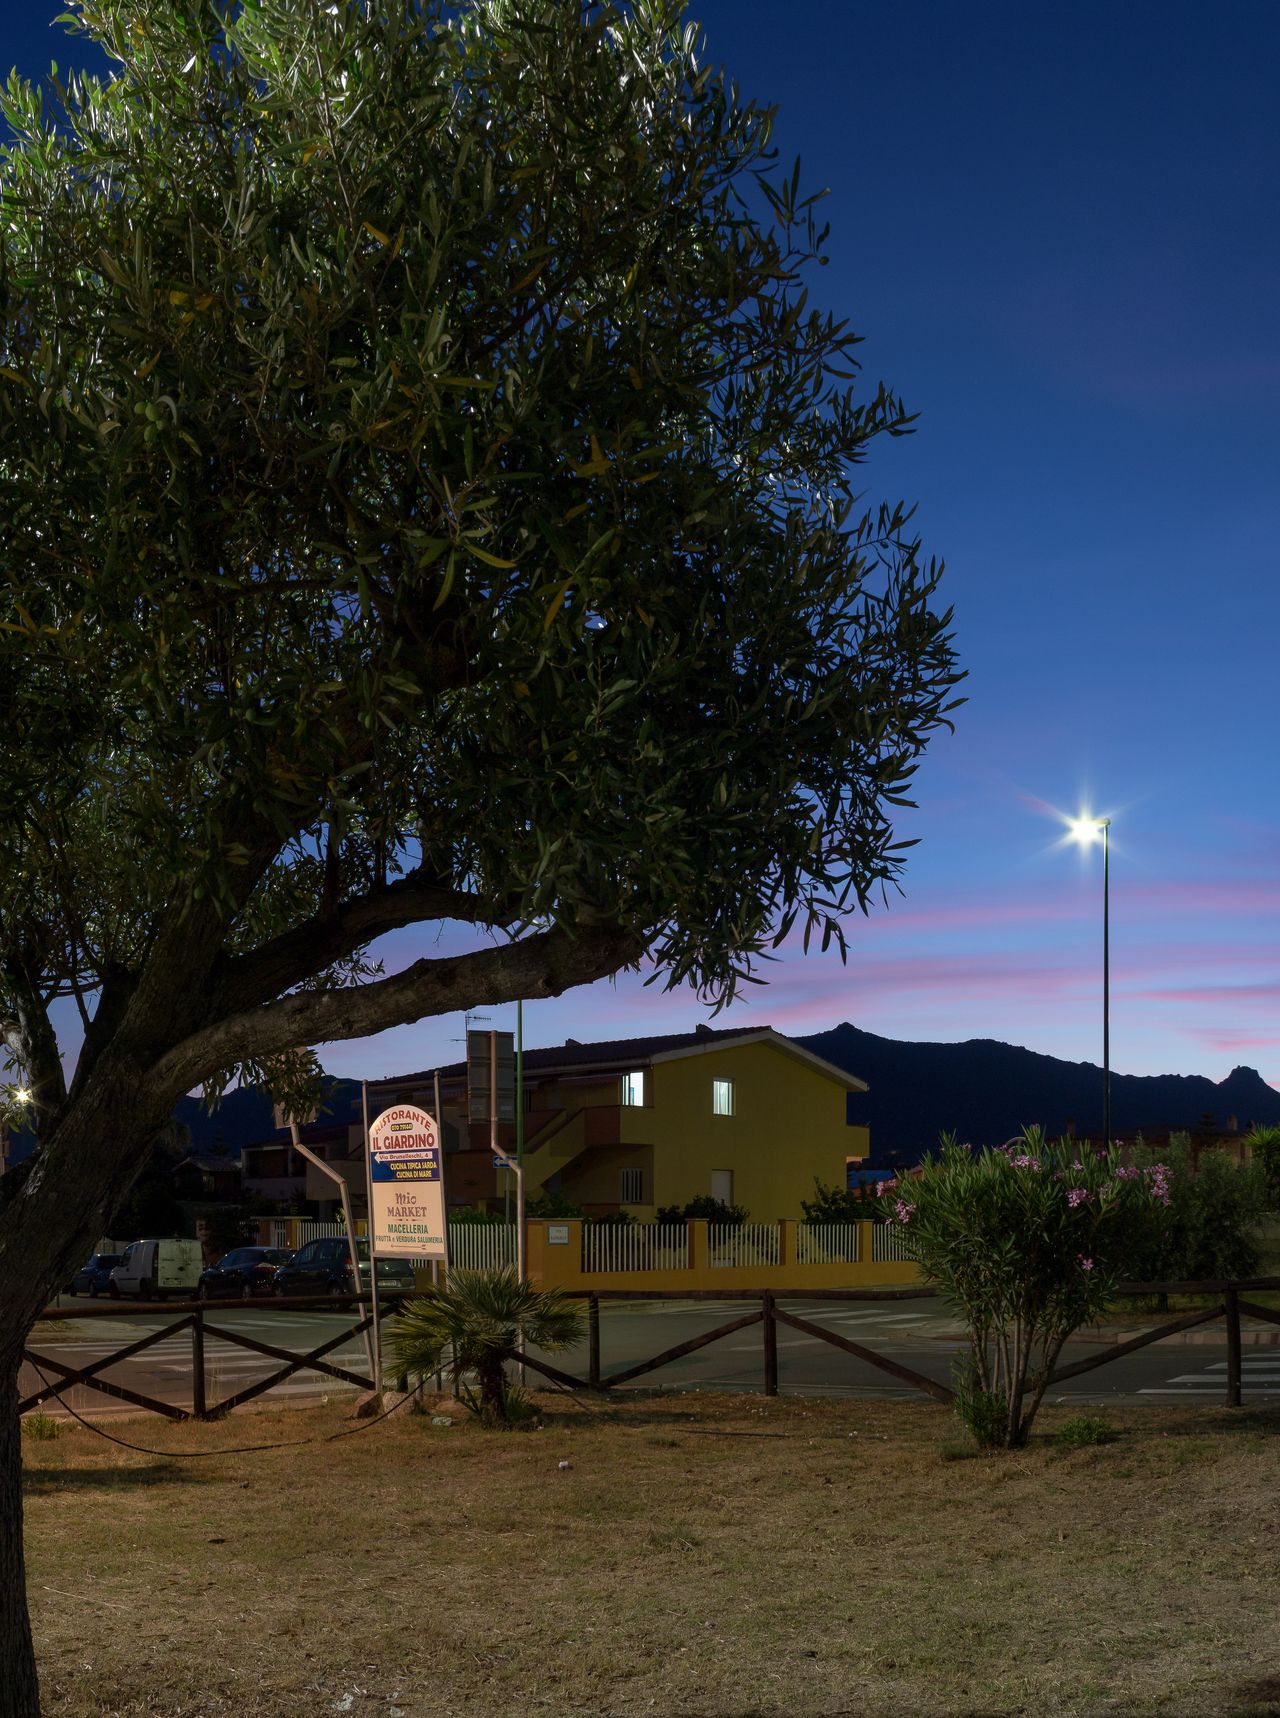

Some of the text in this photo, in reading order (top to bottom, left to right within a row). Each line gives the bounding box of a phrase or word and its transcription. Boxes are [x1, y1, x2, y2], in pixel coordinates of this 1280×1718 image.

[374, 1110, 432, 1135] RISTORANTE
[372, 1133, 435, 1151] IL GIARDINO
[422, 1161, 438, 1169] SARDA
[419, 1170, 432, 1178] MARE
[387, 1206, 427, 1217] MARKET
[387, 1223, 429, 1234] MACELLERIA
[395, 1235, 417, 1243] VERDURA
[417, 1236, 444, 1244] SALUMERIA
